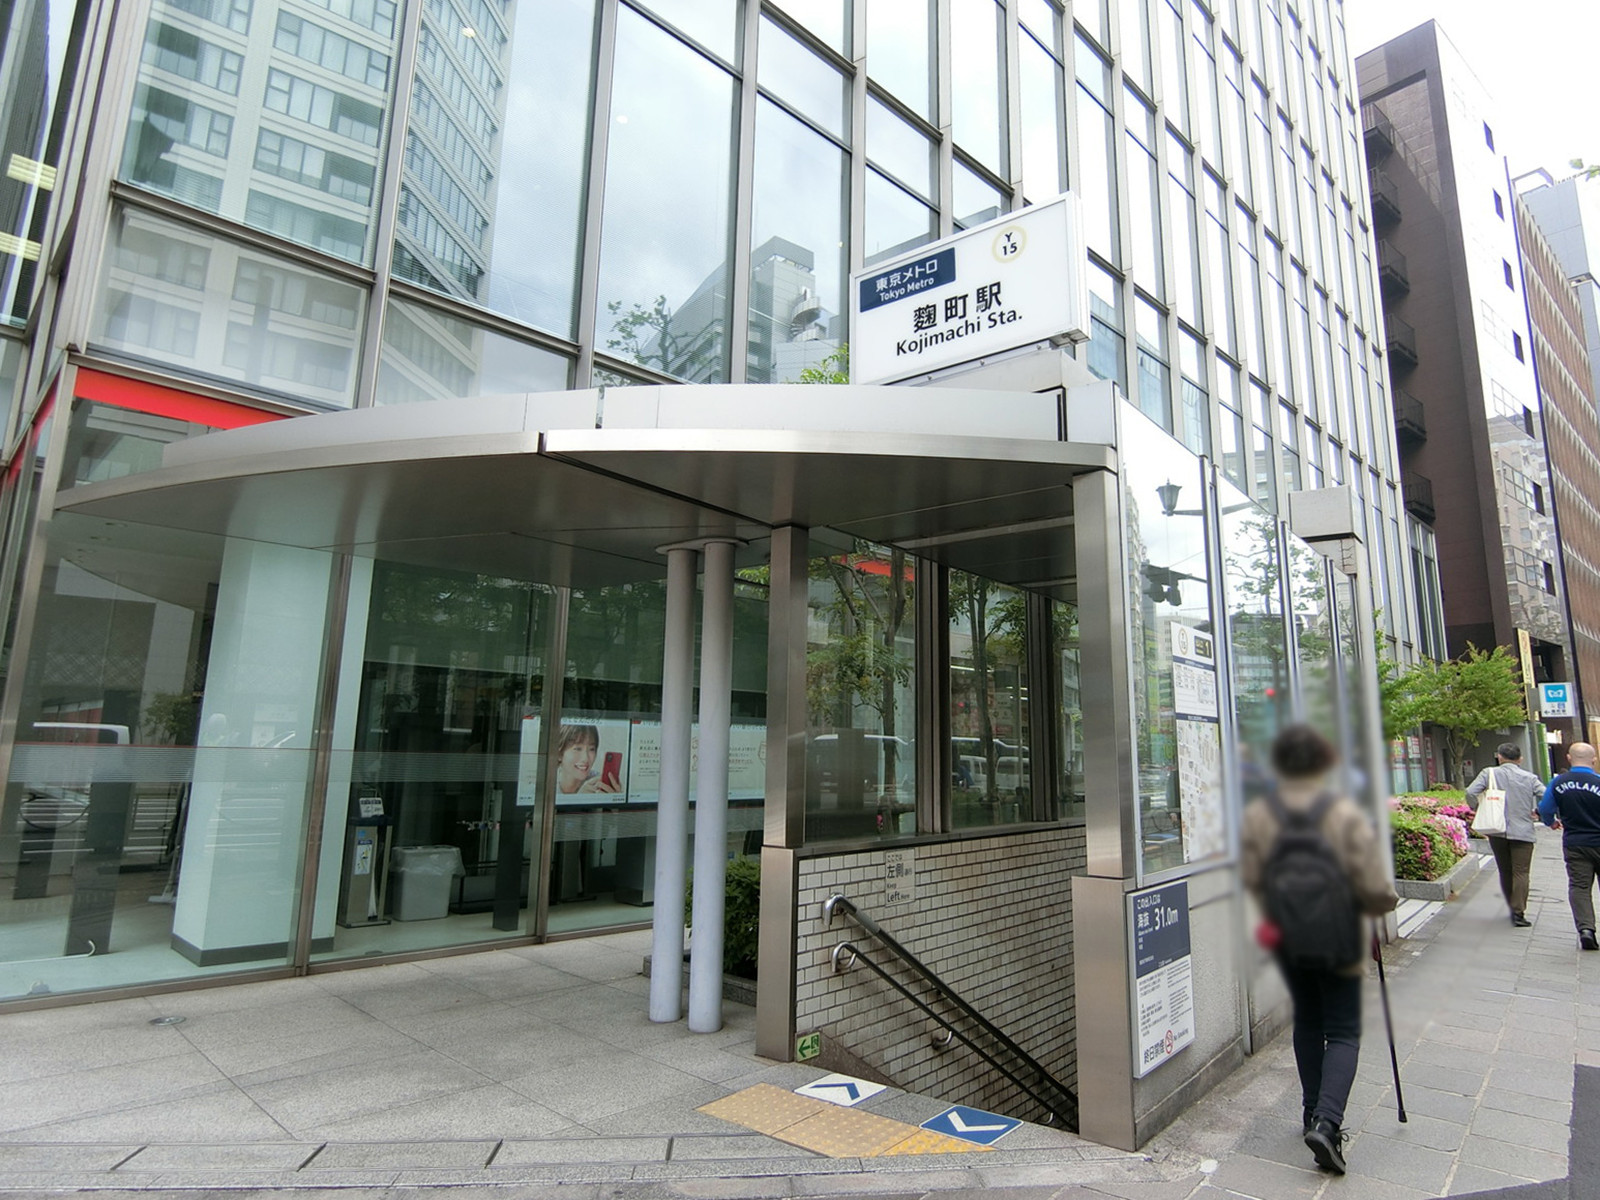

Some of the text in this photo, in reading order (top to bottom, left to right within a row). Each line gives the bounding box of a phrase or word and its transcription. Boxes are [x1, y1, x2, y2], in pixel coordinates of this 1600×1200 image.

[1002, 242, 1018, 256] 15
[1005, 232, 1013, 243] Y
[875, 259, 938, 291] 東京メトロ
[879, 276, 935, 302] Tokyo Metro
[896, 307, 1023, 356] Kojimachi Sta.
[1154, 905, 1179, 931] 31.0m
